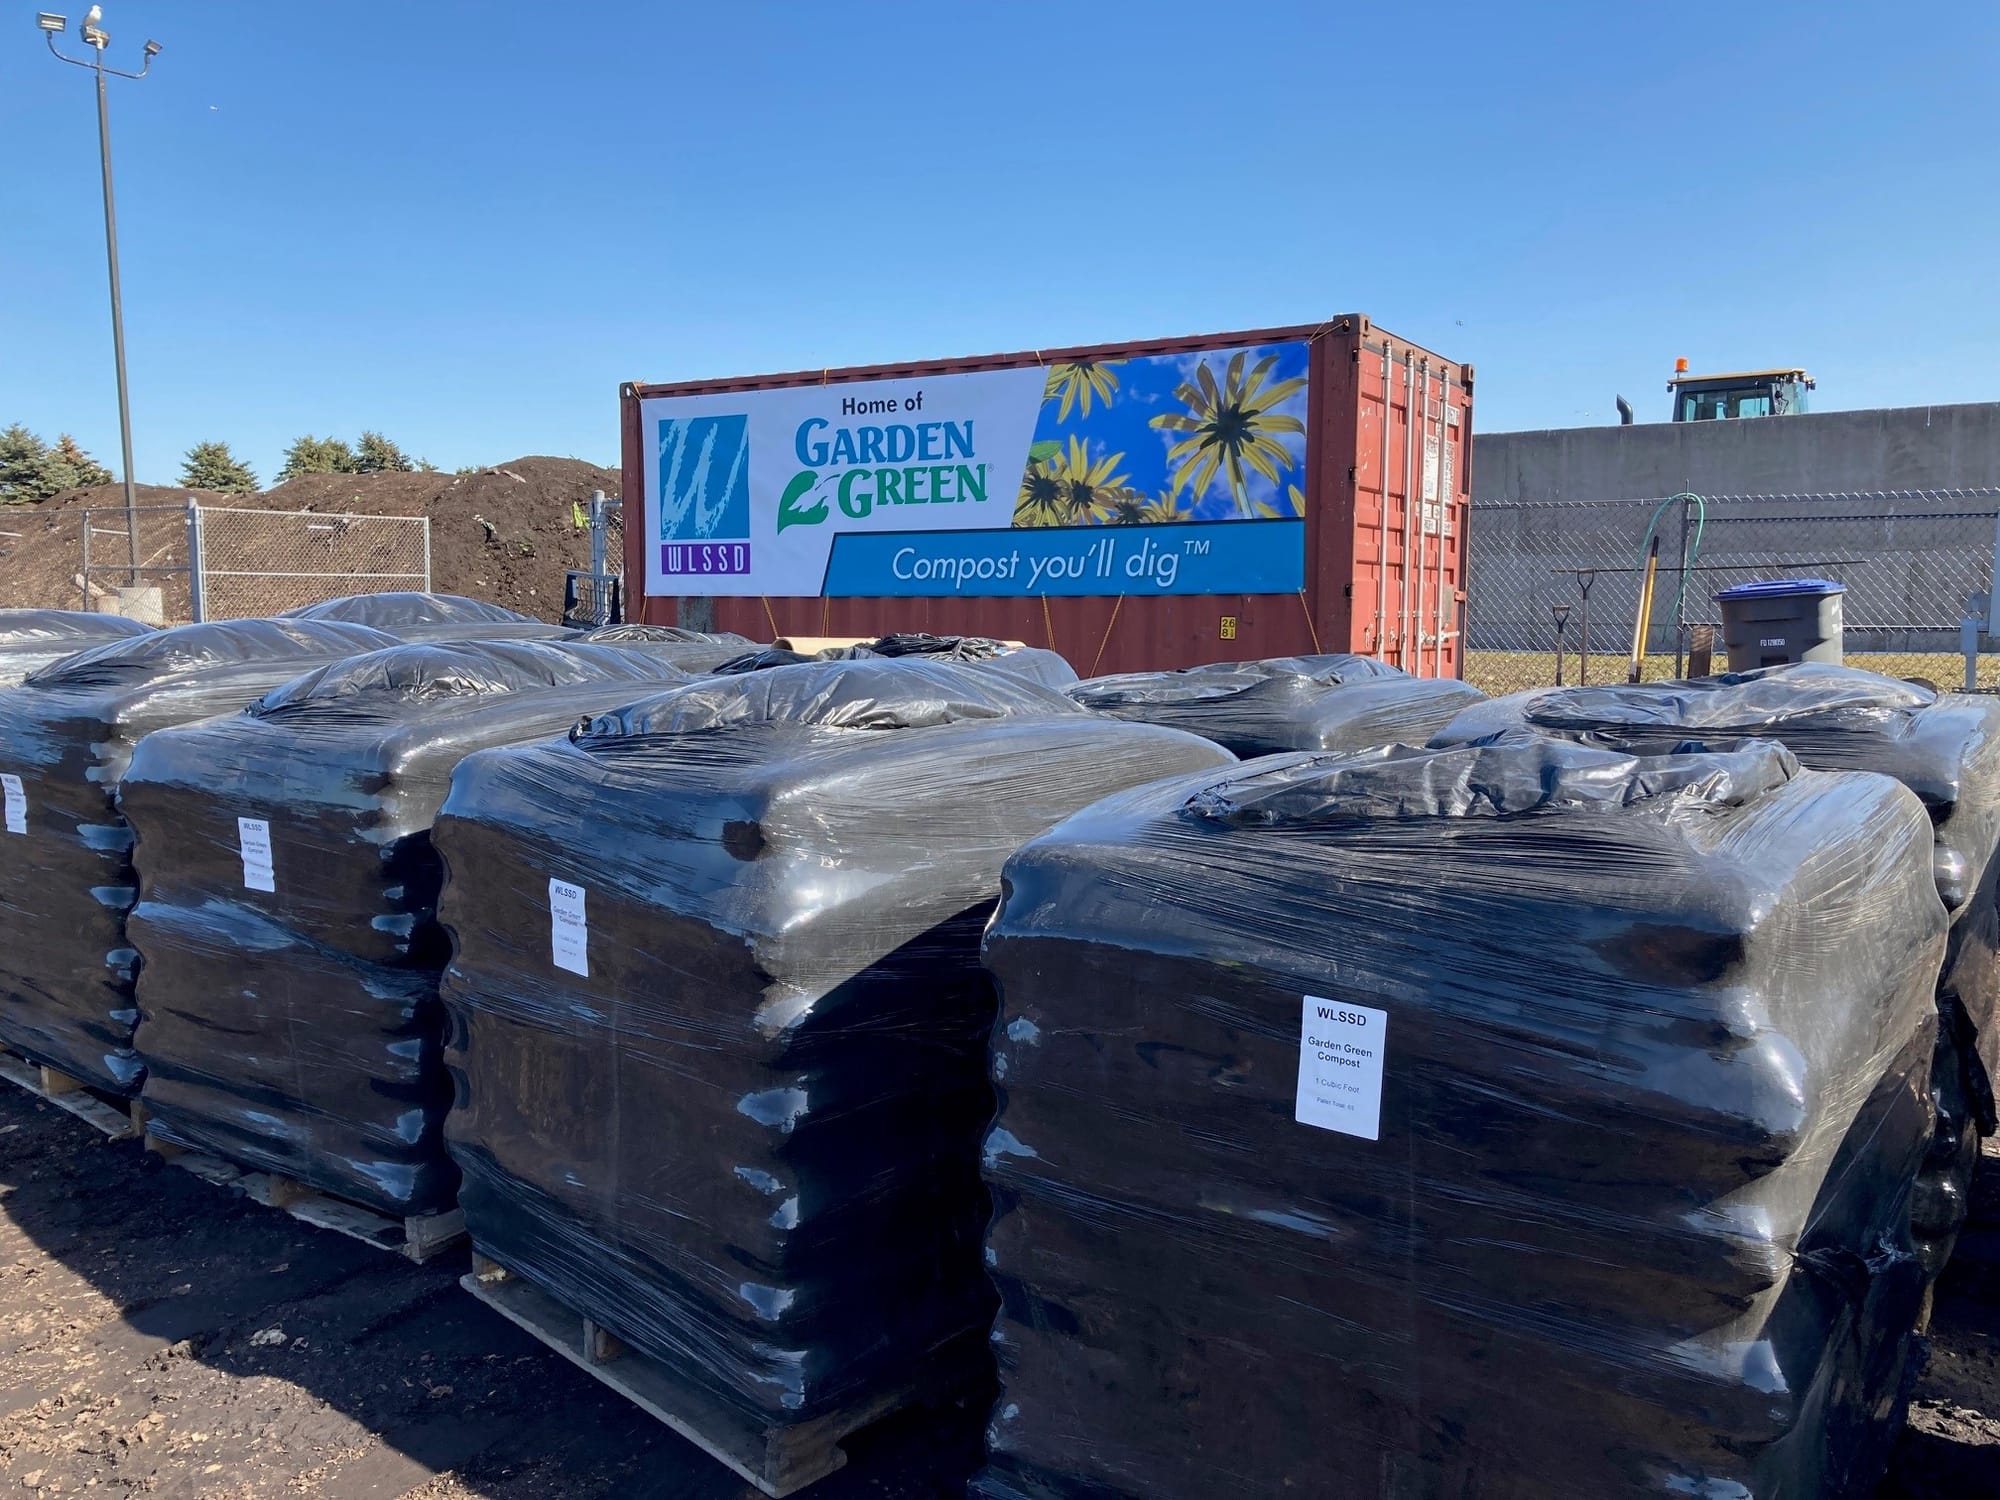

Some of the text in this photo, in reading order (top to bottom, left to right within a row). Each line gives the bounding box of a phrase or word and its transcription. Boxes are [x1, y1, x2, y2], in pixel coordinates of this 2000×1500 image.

[842, 390, 923, 416] Home of
[795, 417, 976, 467] GARDEN
[668, 545, 744, 572] WLSSD
[892, 547, 1020, 589] Compost
[1026, 538, 1116, 589] you'll
[554, 886, 577, 899] WLSSD
[1317, 1006, 1367, 1027] WLSSD
[1307, 1036, 1373, 1058] Garden Green
[1317, 1051, 1361, 1069] Compost
[1320, 1078, 1342, 1091] Cubic
[1342, 1082, 1360, 1094] Foot
